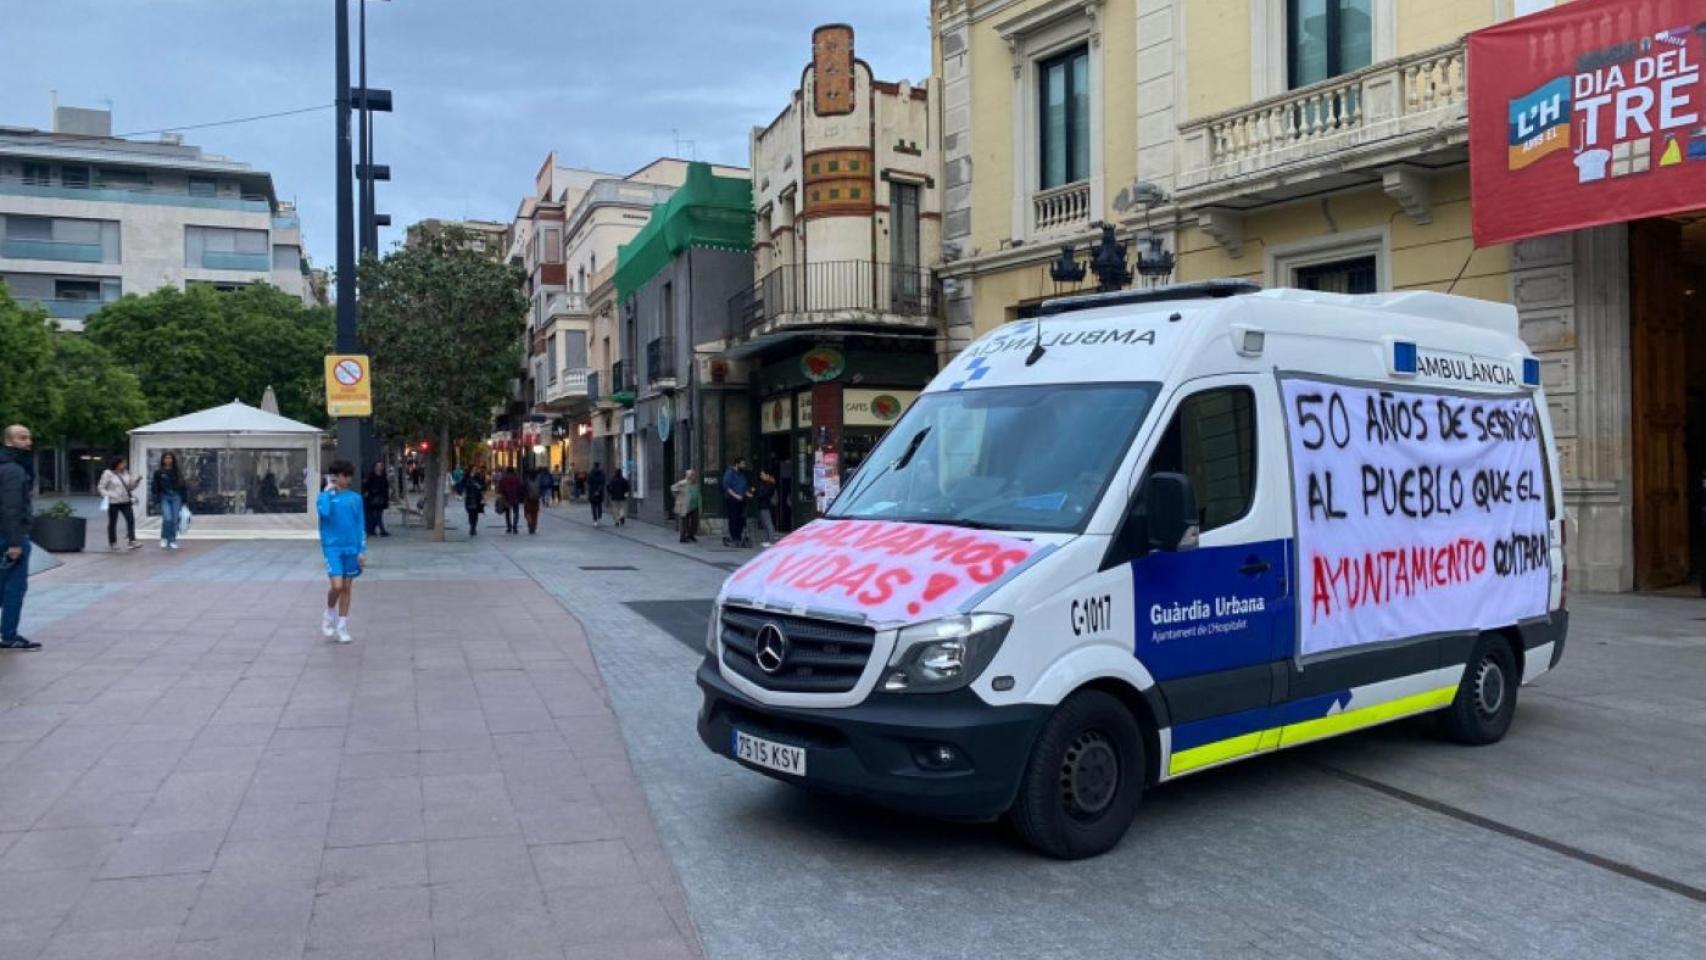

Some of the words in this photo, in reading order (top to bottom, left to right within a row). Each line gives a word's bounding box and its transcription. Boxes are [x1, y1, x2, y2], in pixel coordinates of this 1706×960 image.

[1575, 64, 1626, 98] DIA
[1634, 47, 1699, 84] DEL
[1518, 93, 1560, 138] L'H
[1575, 73, 1699, 145] TRE
[1296, 392, 1350, 450] 50
[1365, 391, 1429, 445] AÑOS
[1437, 398, 1469, 441] DE
[1308, 471, 1348, 521] AL
[1361, 464, 1464, 518] PUEBLO
[1472, 470, 1512, 512] QUE
[1516, 470, 1541, 502] EL
[1310, 537, 1486, 625] AYUNTAMIENTO
[1070, 594, 1112, 636] C-1017
[1150, 601, 1211, 625] Guàrdia
[1215, 595, 1265, 617] Urbana
[739, 736, 768, 763] 7515
[772, 745, 799, 771] KSV
